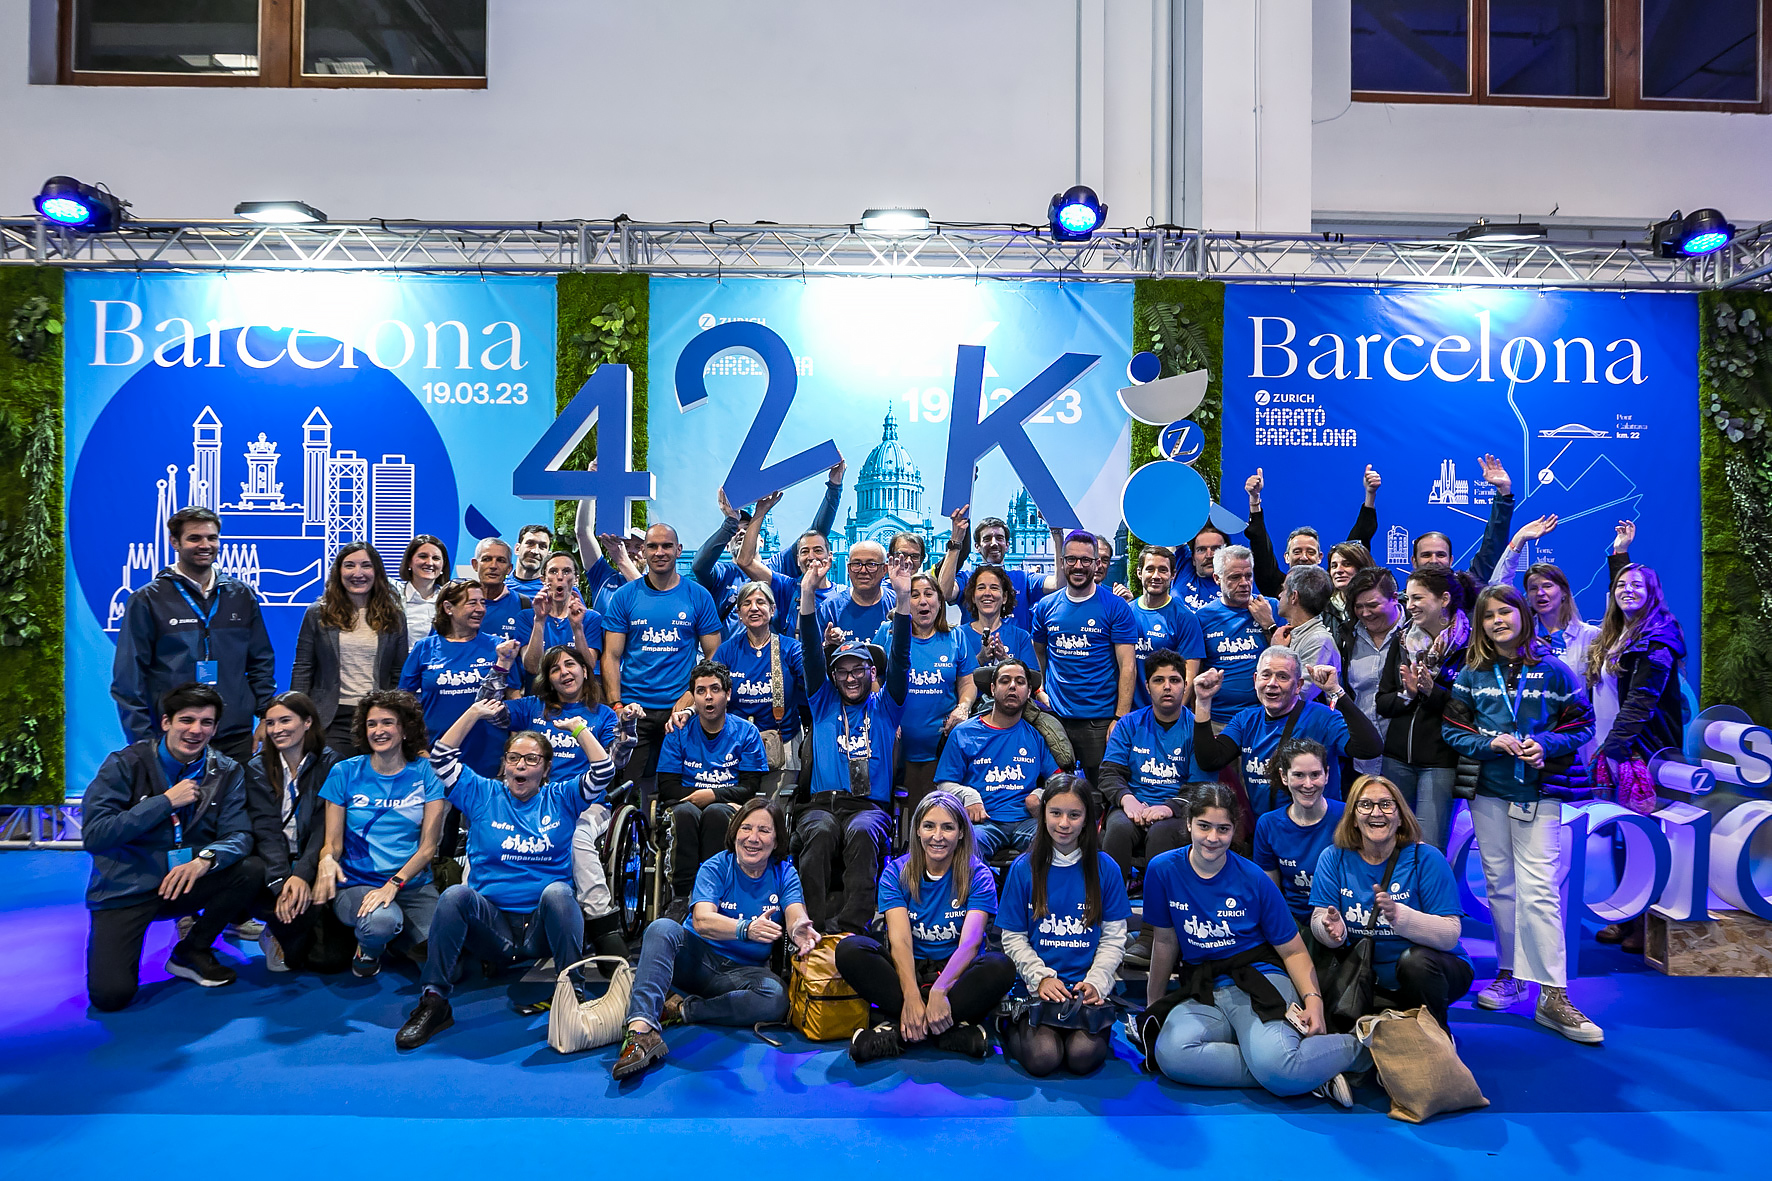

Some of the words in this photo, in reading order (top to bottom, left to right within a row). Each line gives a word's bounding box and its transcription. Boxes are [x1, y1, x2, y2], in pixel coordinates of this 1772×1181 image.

[1248, 310, 1649, 385] Barcelona
[423, 381, 529, 405] 19.03.23
[1273, 393, 1315, 403] ZURICH
[1255, 405, 1326, 426] MARATÓ
[1255, 427, 1357, 447] BARCELONA
[1216, 909, 1245, 918] ZURICH
[1039, 938, 1091, 949] #Imparables
